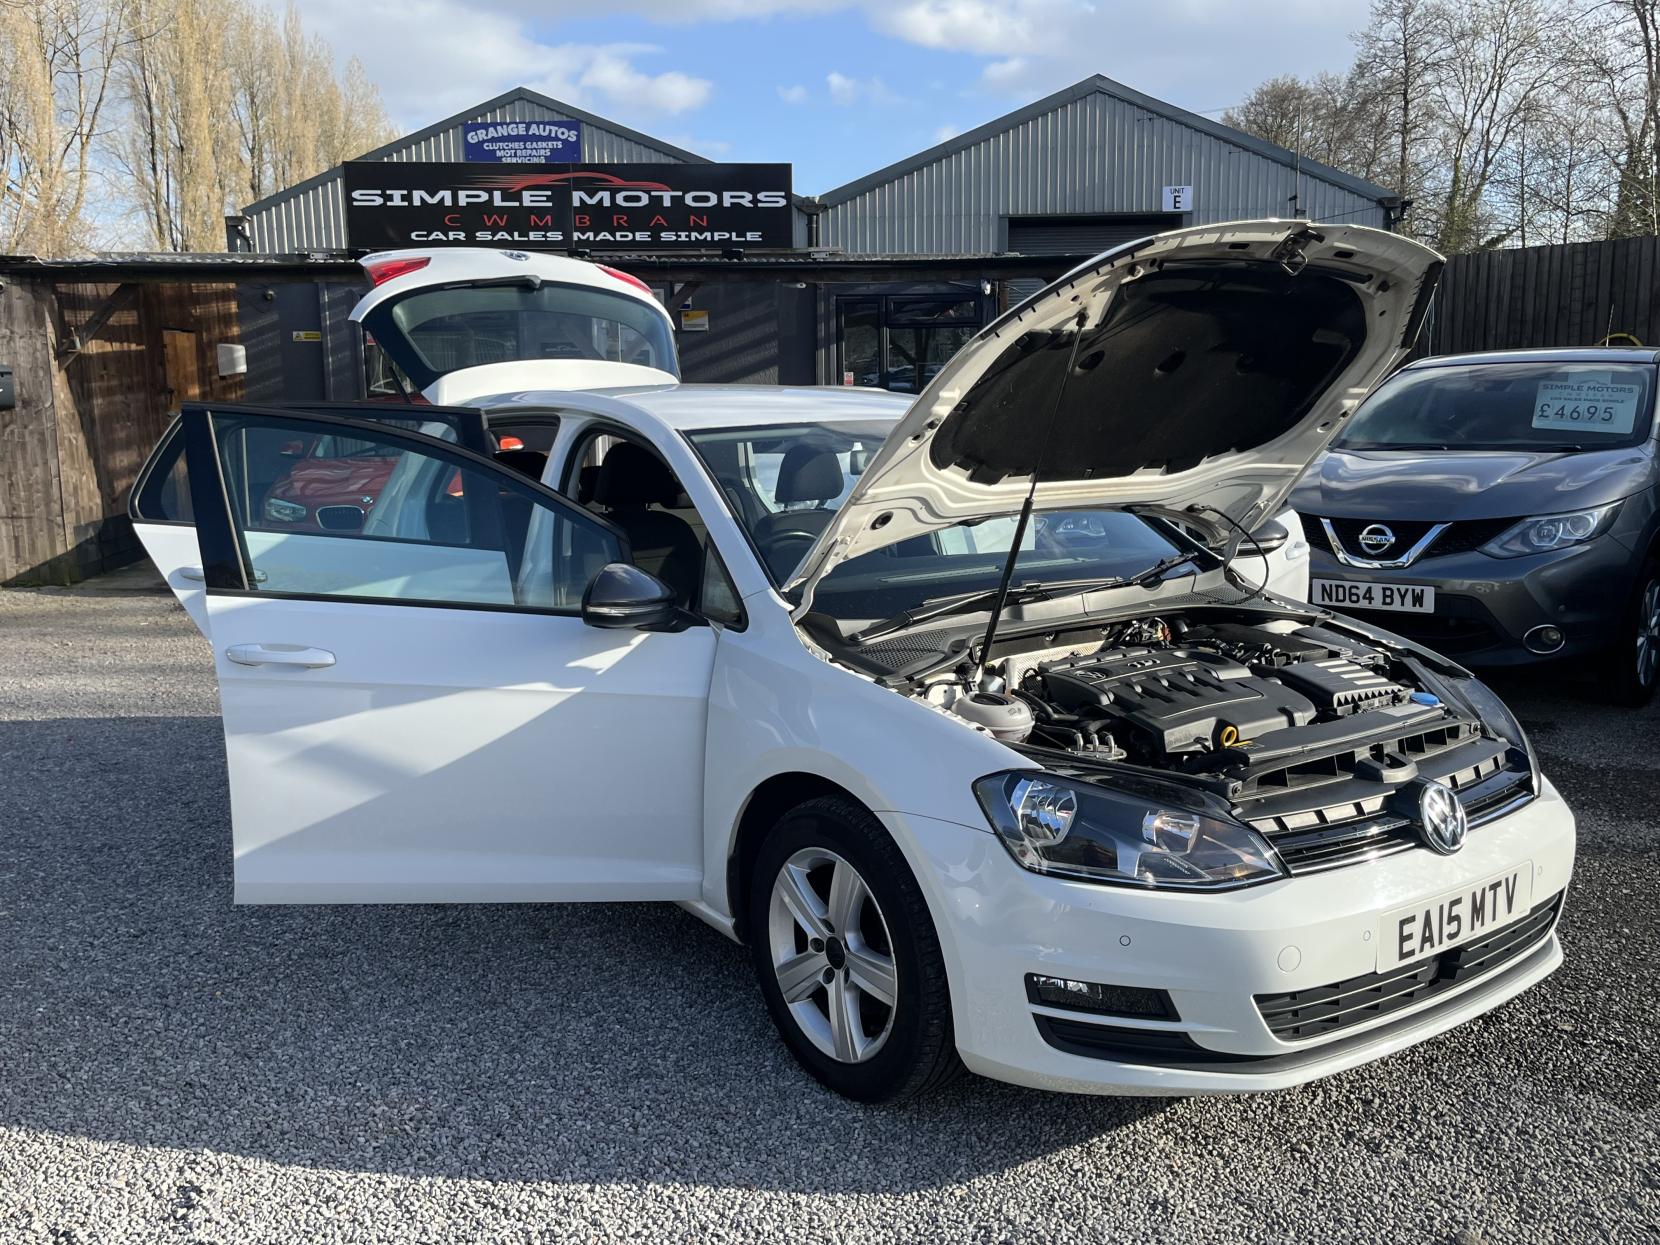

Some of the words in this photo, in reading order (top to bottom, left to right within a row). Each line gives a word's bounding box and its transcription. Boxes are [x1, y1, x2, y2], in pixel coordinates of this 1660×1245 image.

[467, 124, 526, 143] GRANGE
[528, 124, 578, 141] AUTOS
[483, 142, 524, 150] CLUTCHES
[525, 141, 562, 149] GASKETS
[517, 149, 551, 157] REPAIRS
[351, 190, 553, 207] SIMPLE
[572, 190, 787, 208] MOTORS
[1173, 195, 1181, 209] E
[410, 231, 466, 241] CAR
[475, 231, 563, 241] SALES
[573, 231, 651, 241] MADE
[660, 231, 763, 241] SIMPLE
[1542, 384, 1584, 392] SIMPLE
[1586, 385, 1634, 393] MOTORS
[1538, 403, 1614, 422] £4695
[1321, 583, 1374, 605] ND64
[1381, 586, 1424, 608] BYW
[1398, 896, 1463, 962] EA15
[1470, 872, 1518, 932] MTV
